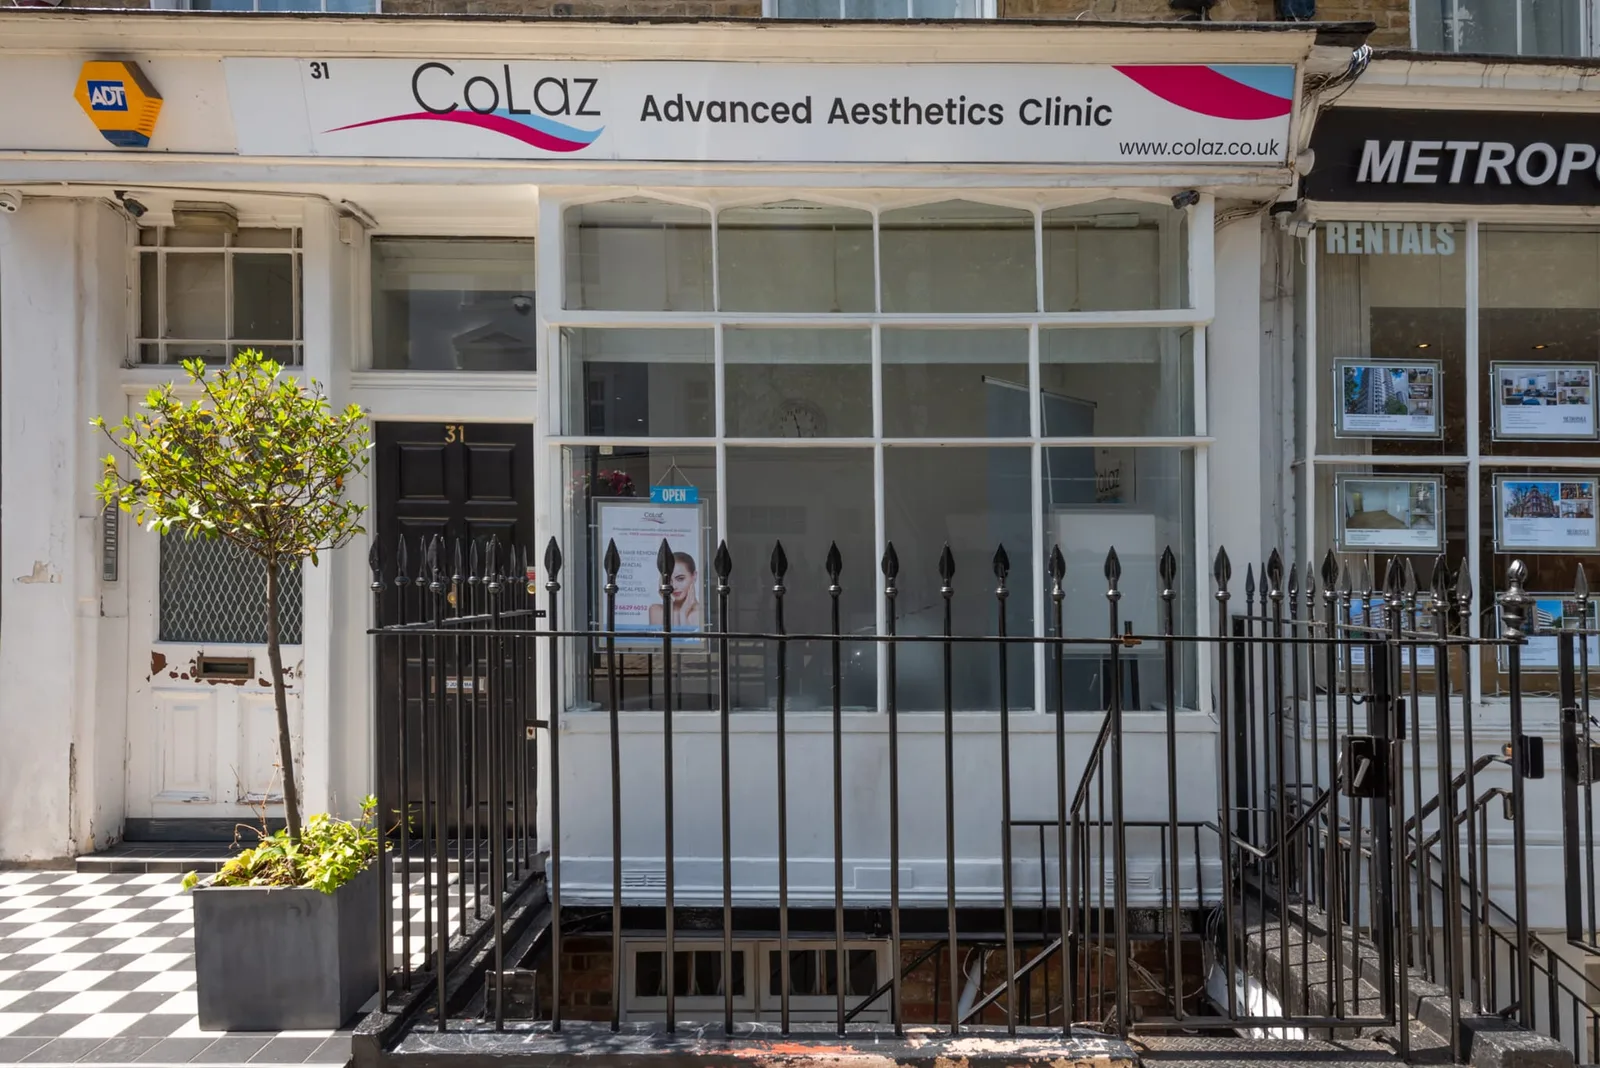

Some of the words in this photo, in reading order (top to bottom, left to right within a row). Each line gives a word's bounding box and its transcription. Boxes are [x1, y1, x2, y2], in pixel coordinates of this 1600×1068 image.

[309, 61, 330, 80] 31
[91, 85, 125, 107] ADT
[411, 61, 602, 117] CoLaz
[640, 93, 812, 125] Advanced
[827, 95, 1004, 126] Aesthetics
[1018, 97, 1113, 127] Clinic
[1119, 137, 1280, 157] www.colaz.co.uk
[1356, 139, 1600, 187] METROP
[1326, 221, 1455, 256] RENTALS
[444, 425, 465, 443] 31
[662, 488, 686, 501] OPEN
